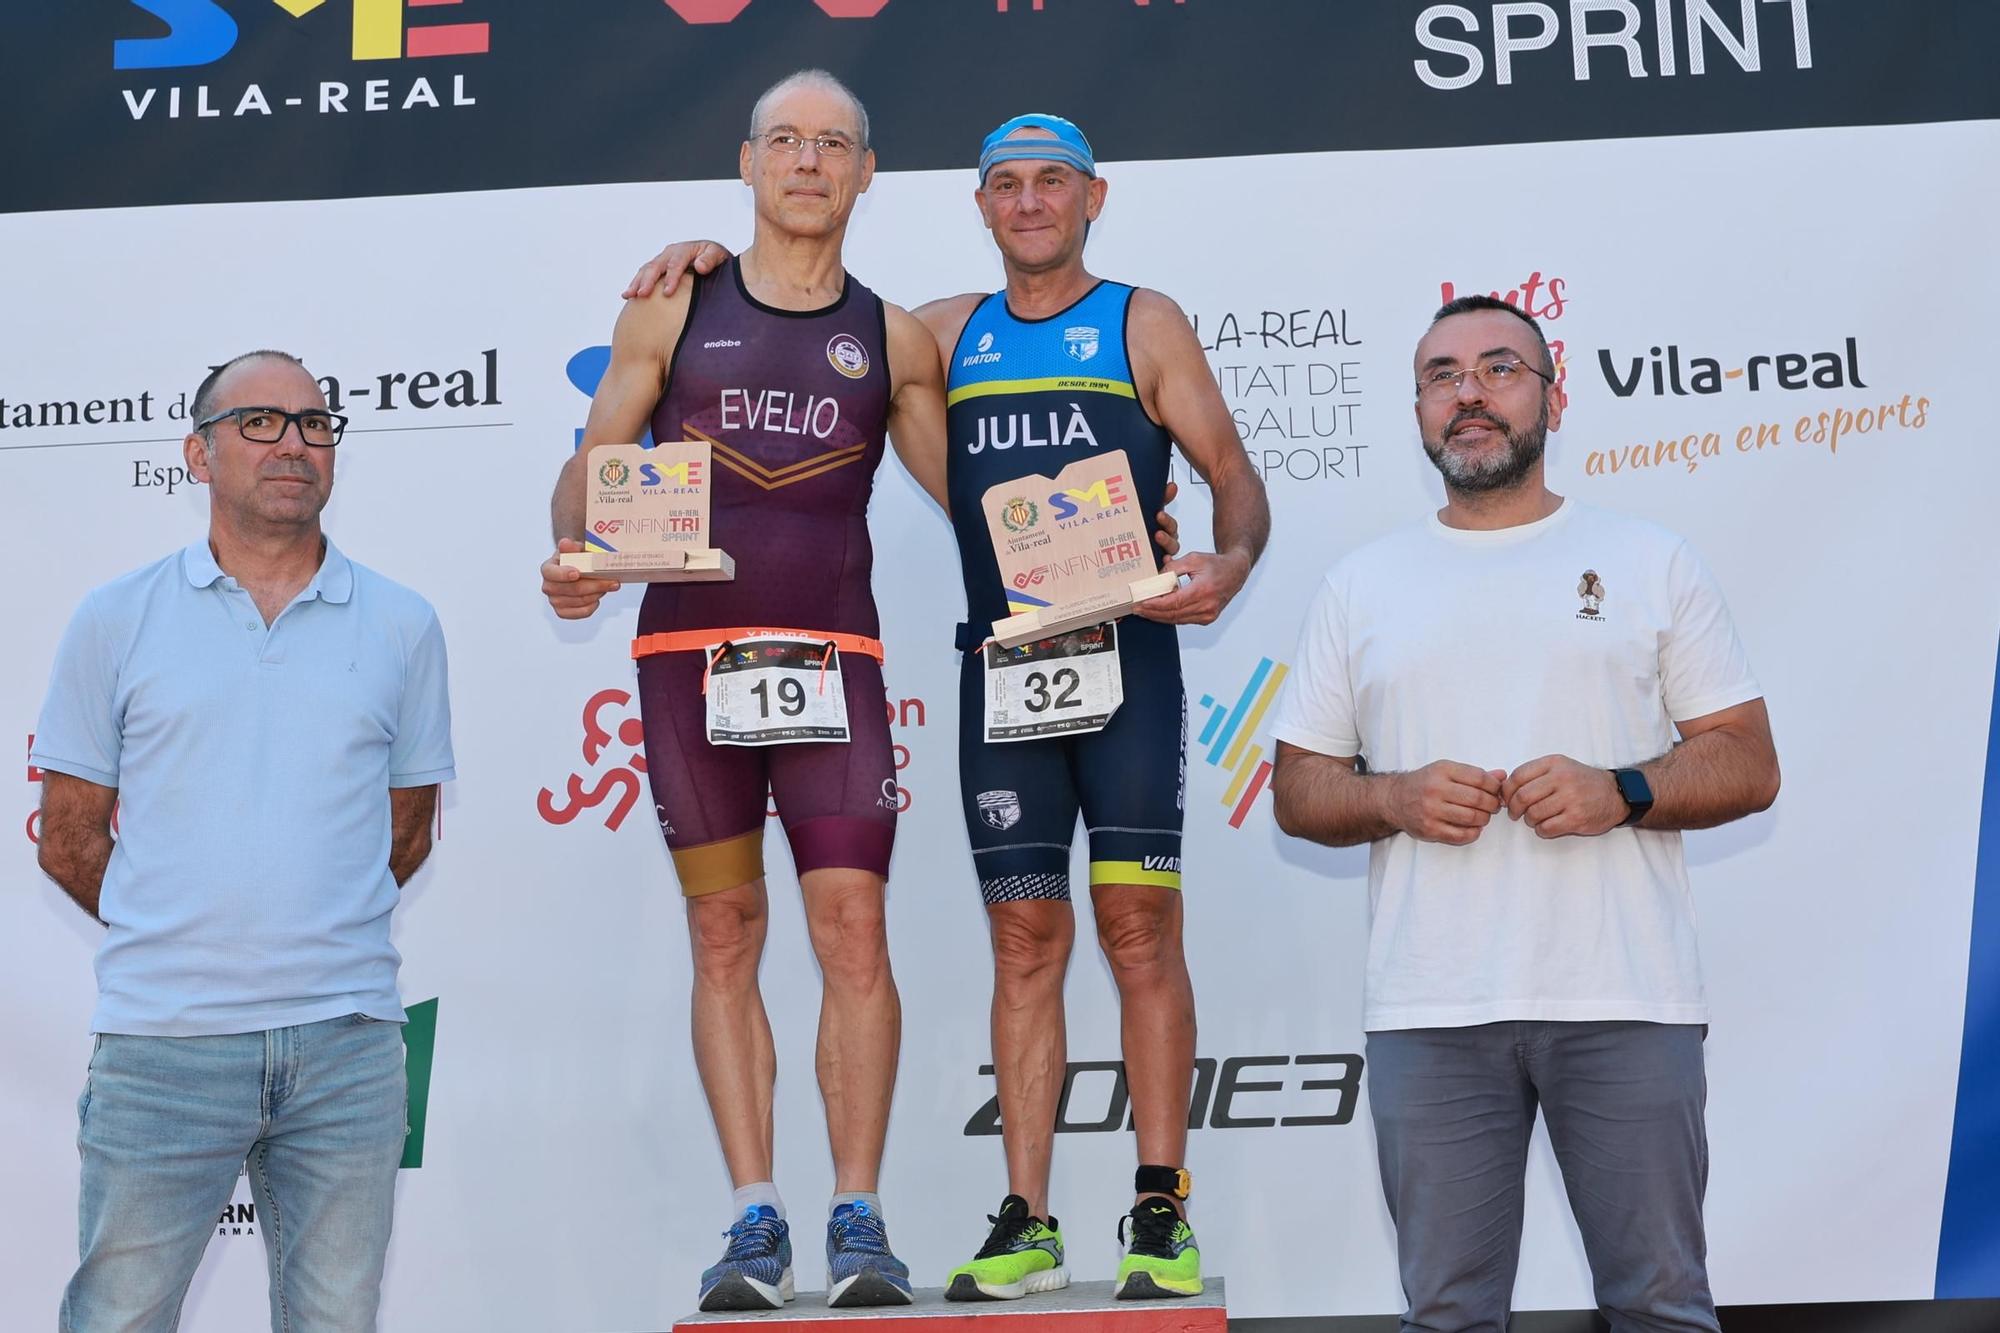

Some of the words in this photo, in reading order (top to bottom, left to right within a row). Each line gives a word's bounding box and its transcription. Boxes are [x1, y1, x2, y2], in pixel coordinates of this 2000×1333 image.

[1414, 0, 1812, 90] SPRINT
[122, 75, 475, 120] VILA-REAL
[1192, 309, 1362, 351] LA-REAL
[963, 352, 1001, 367] VIATOR
[1308, 362, 1362, 396] DE
[1598, 337, 1869, 397] Vila-real
[0, 391, 154, 429] tament
[721, 389, 839, 439] EVELIO
[968, 403, 1099, 454] JULIÀ
[1231, 404, 1362, 441] SALUT
[1585, 432, 1721, 476] avança
[1736, 423, 1780, 452] en
[1794, 394, 1931, 454] esports
[639, 462, 702, 487] SME
[642, 488, 700, 496] VILA-REAL
[1048, 475, 1128, 521] SME
[1058, 506, 1128, 531] VILA-REAL
[662, 533, 699, 542] SPRINT
[1010, 535, 1051, 553] Vila-real
[750, 677, 806, 719] 19
[1024, 668, 1082, 713] 32
